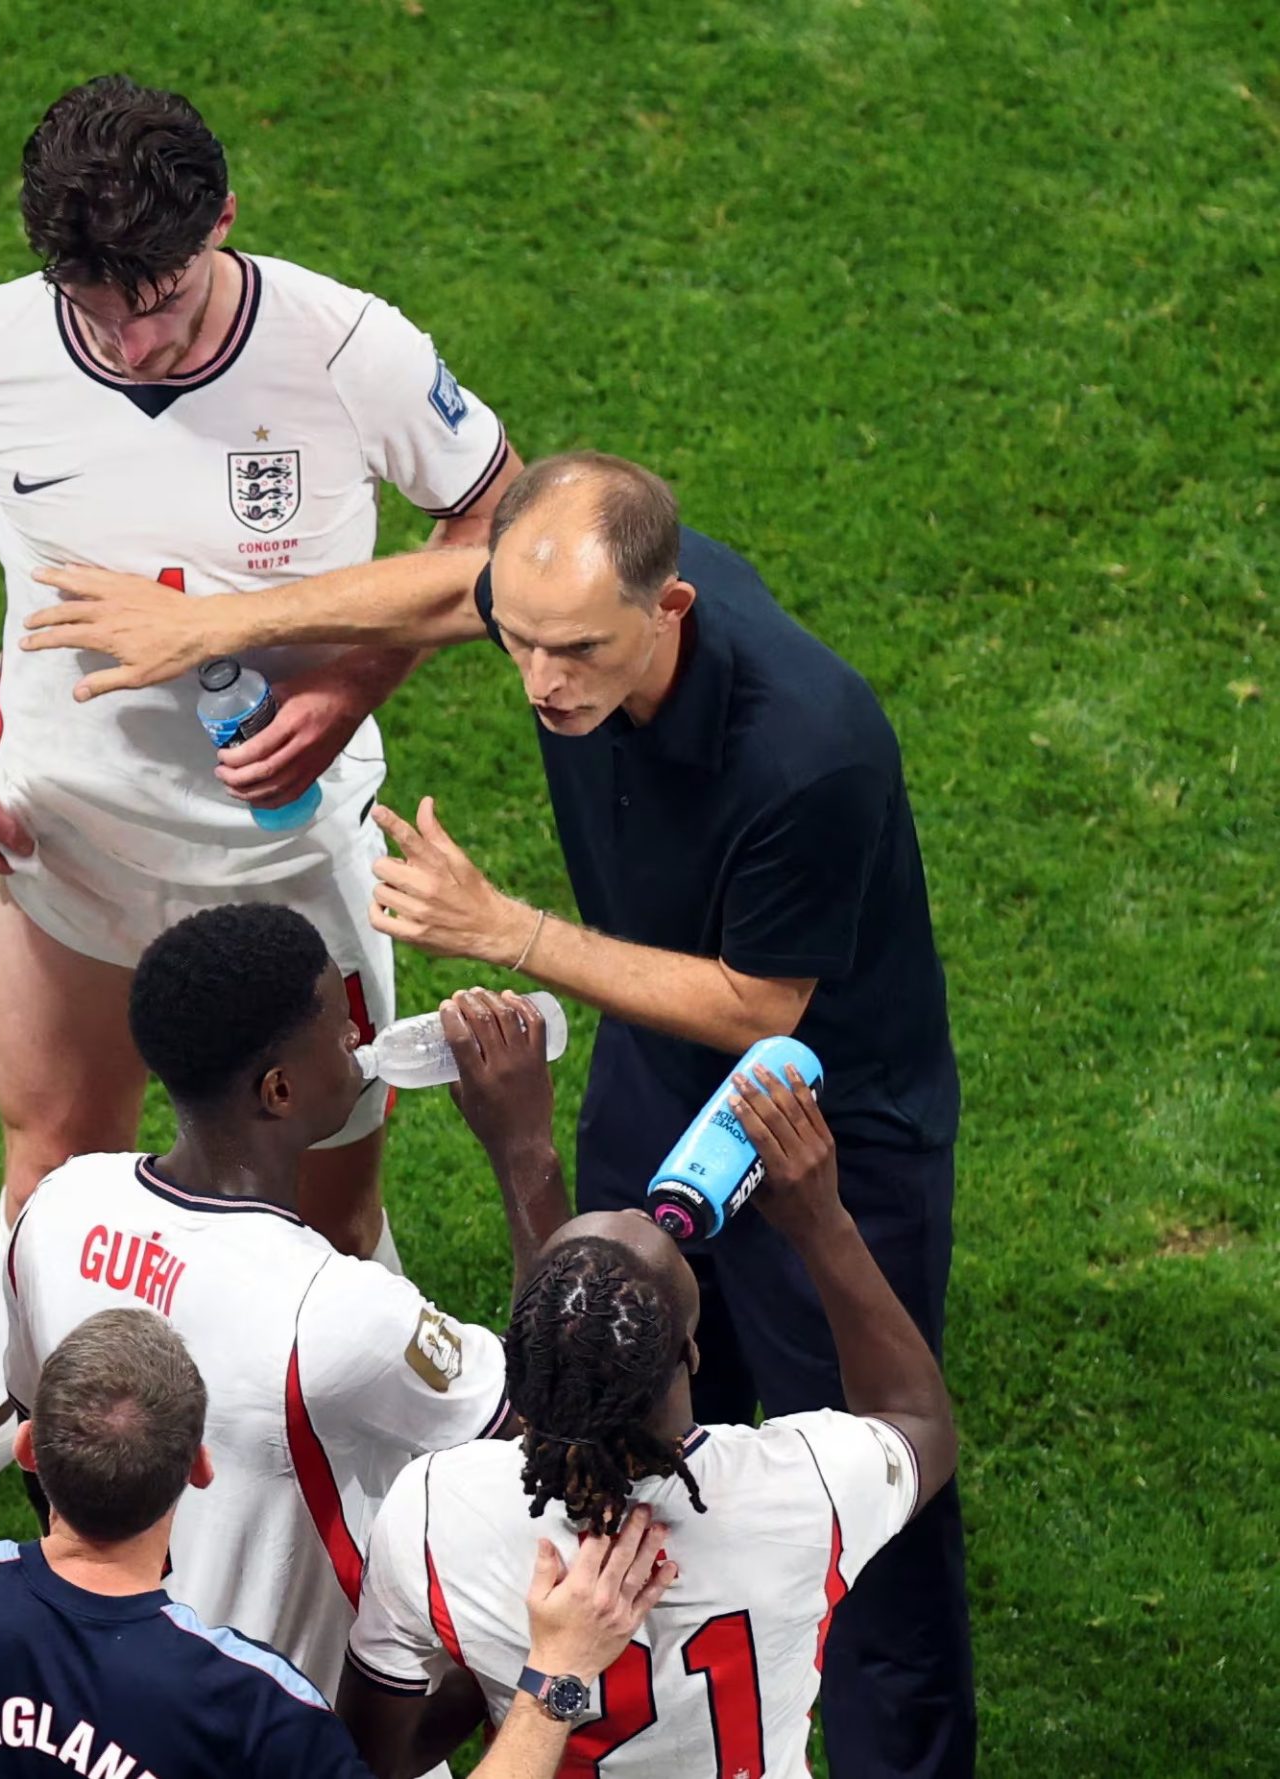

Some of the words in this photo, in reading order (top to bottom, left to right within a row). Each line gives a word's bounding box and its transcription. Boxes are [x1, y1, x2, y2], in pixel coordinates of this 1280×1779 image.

[238, 541, 280, 553] CONGO
[282, 538, 299, 549] DR
[688, 1162, 707, 1176] 13
[79, 1224, 187, 1318] GUÉHI
